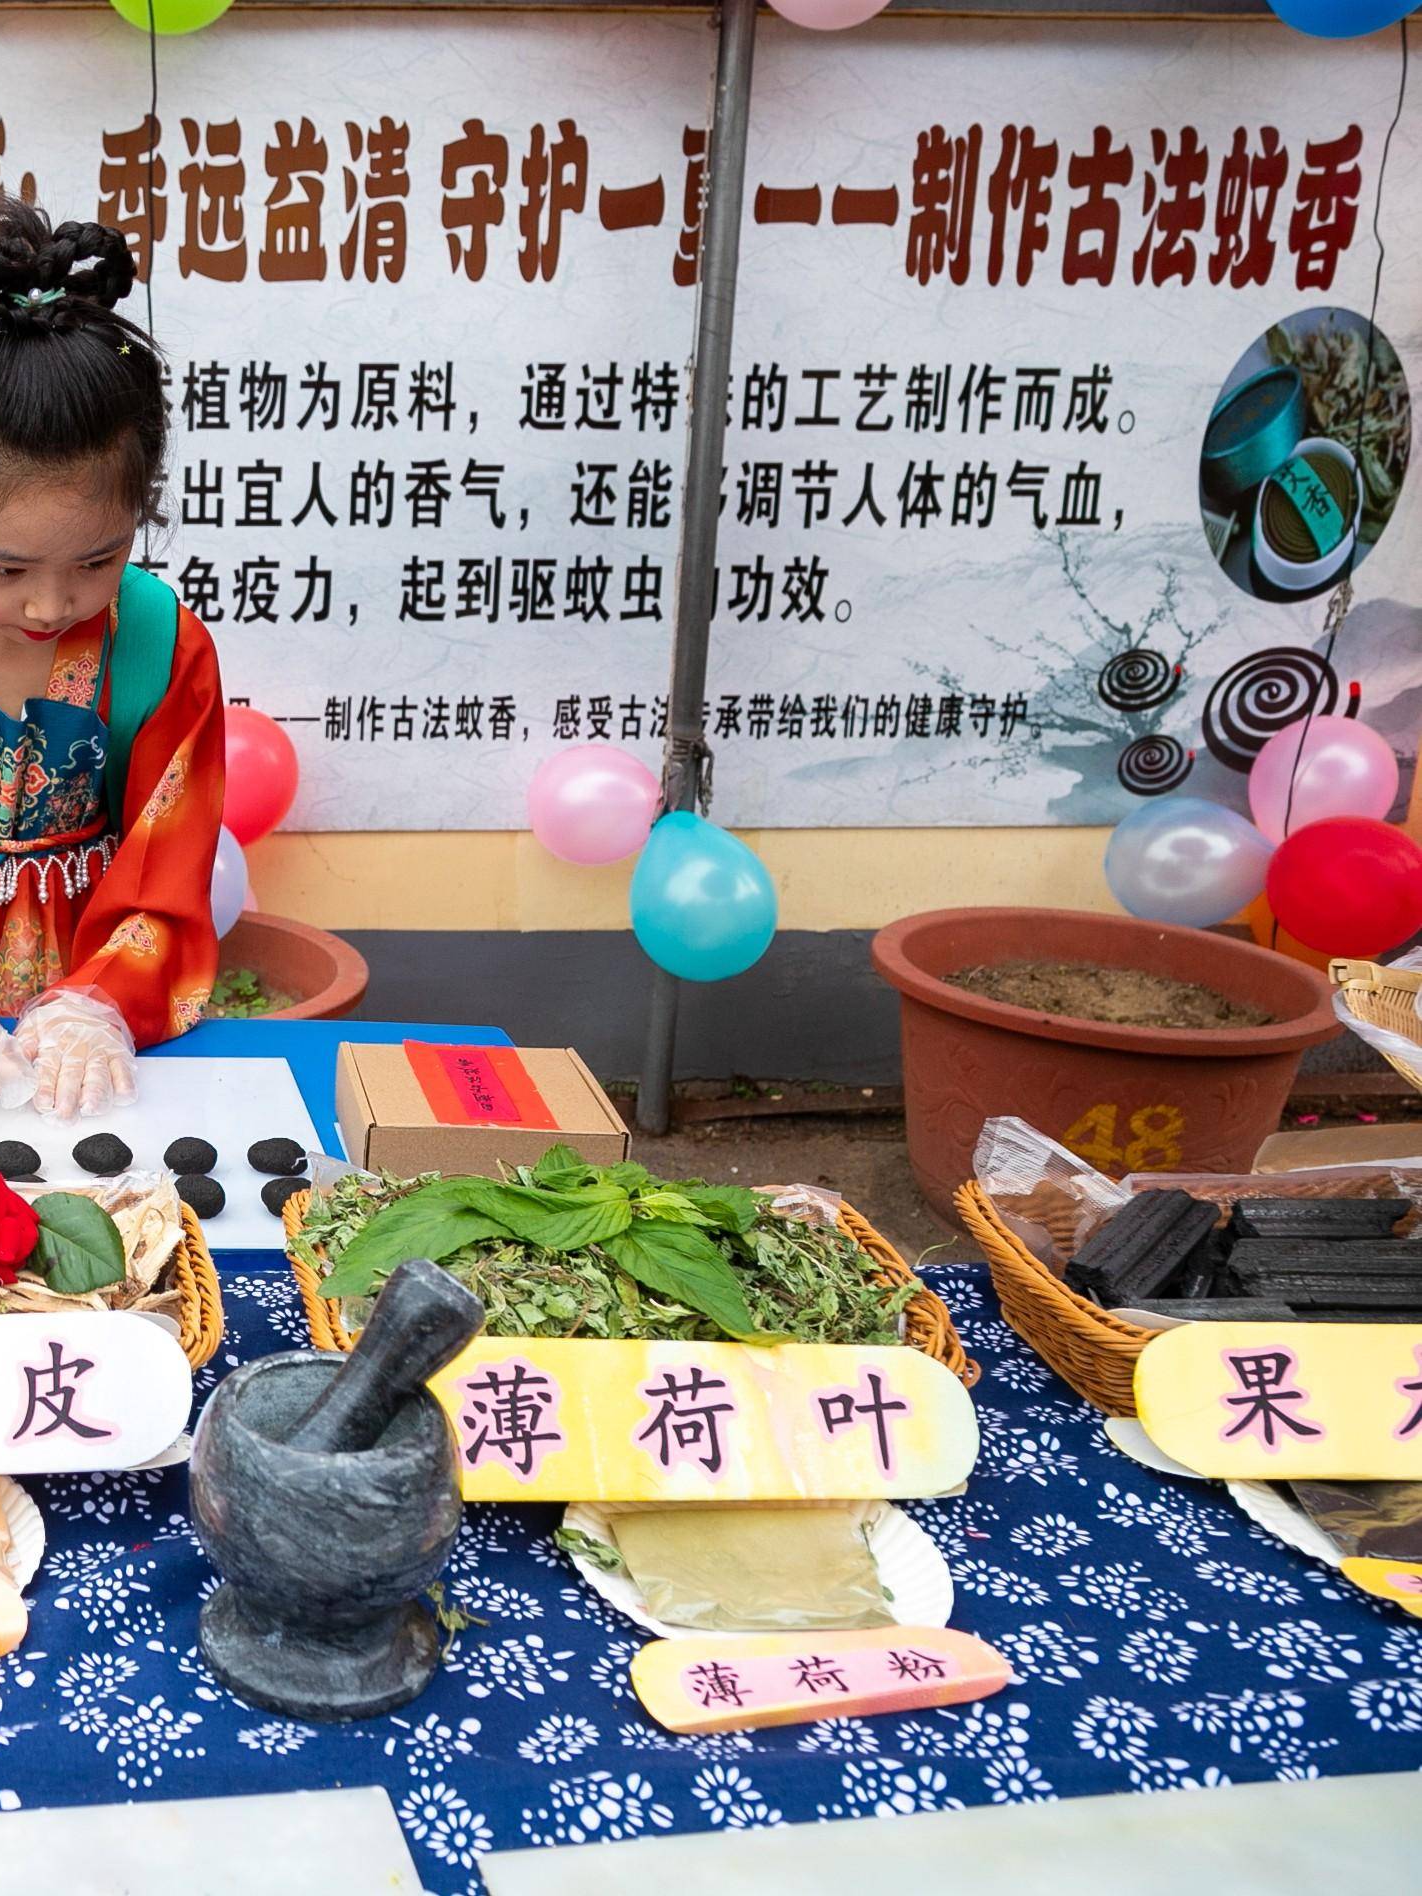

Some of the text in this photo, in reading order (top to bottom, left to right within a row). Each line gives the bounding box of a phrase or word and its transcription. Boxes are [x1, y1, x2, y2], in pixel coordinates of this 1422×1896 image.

[1063, 1104, 1185, 1171] 48
[464, 1365, 906, 1474] 薄荷叶
[689, 1648, 947, 1708] 薄荷粉
